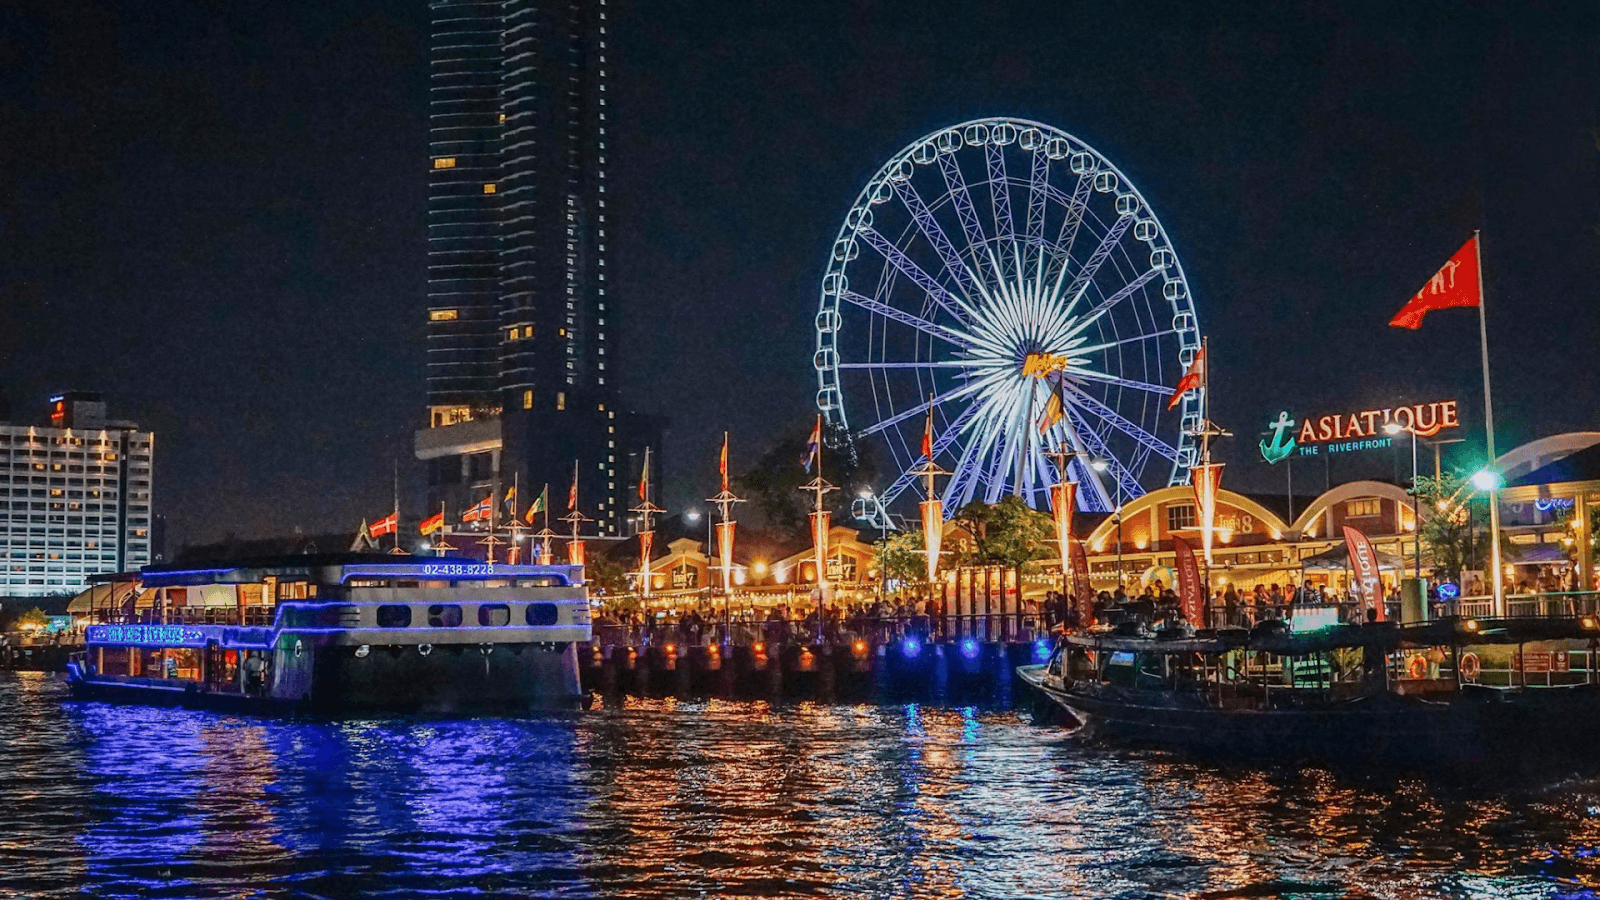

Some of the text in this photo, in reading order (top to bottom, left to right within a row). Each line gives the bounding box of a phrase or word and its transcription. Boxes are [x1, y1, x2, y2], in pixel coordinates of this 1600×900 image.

[1297, 400, 1460, 443] ASIATIQUE
[1299, 438, 1392, 456] THE RIVERFRONT
[1241, 515, 1253, 534] 8
[424, 564, 494, 575] 02-438-8228
